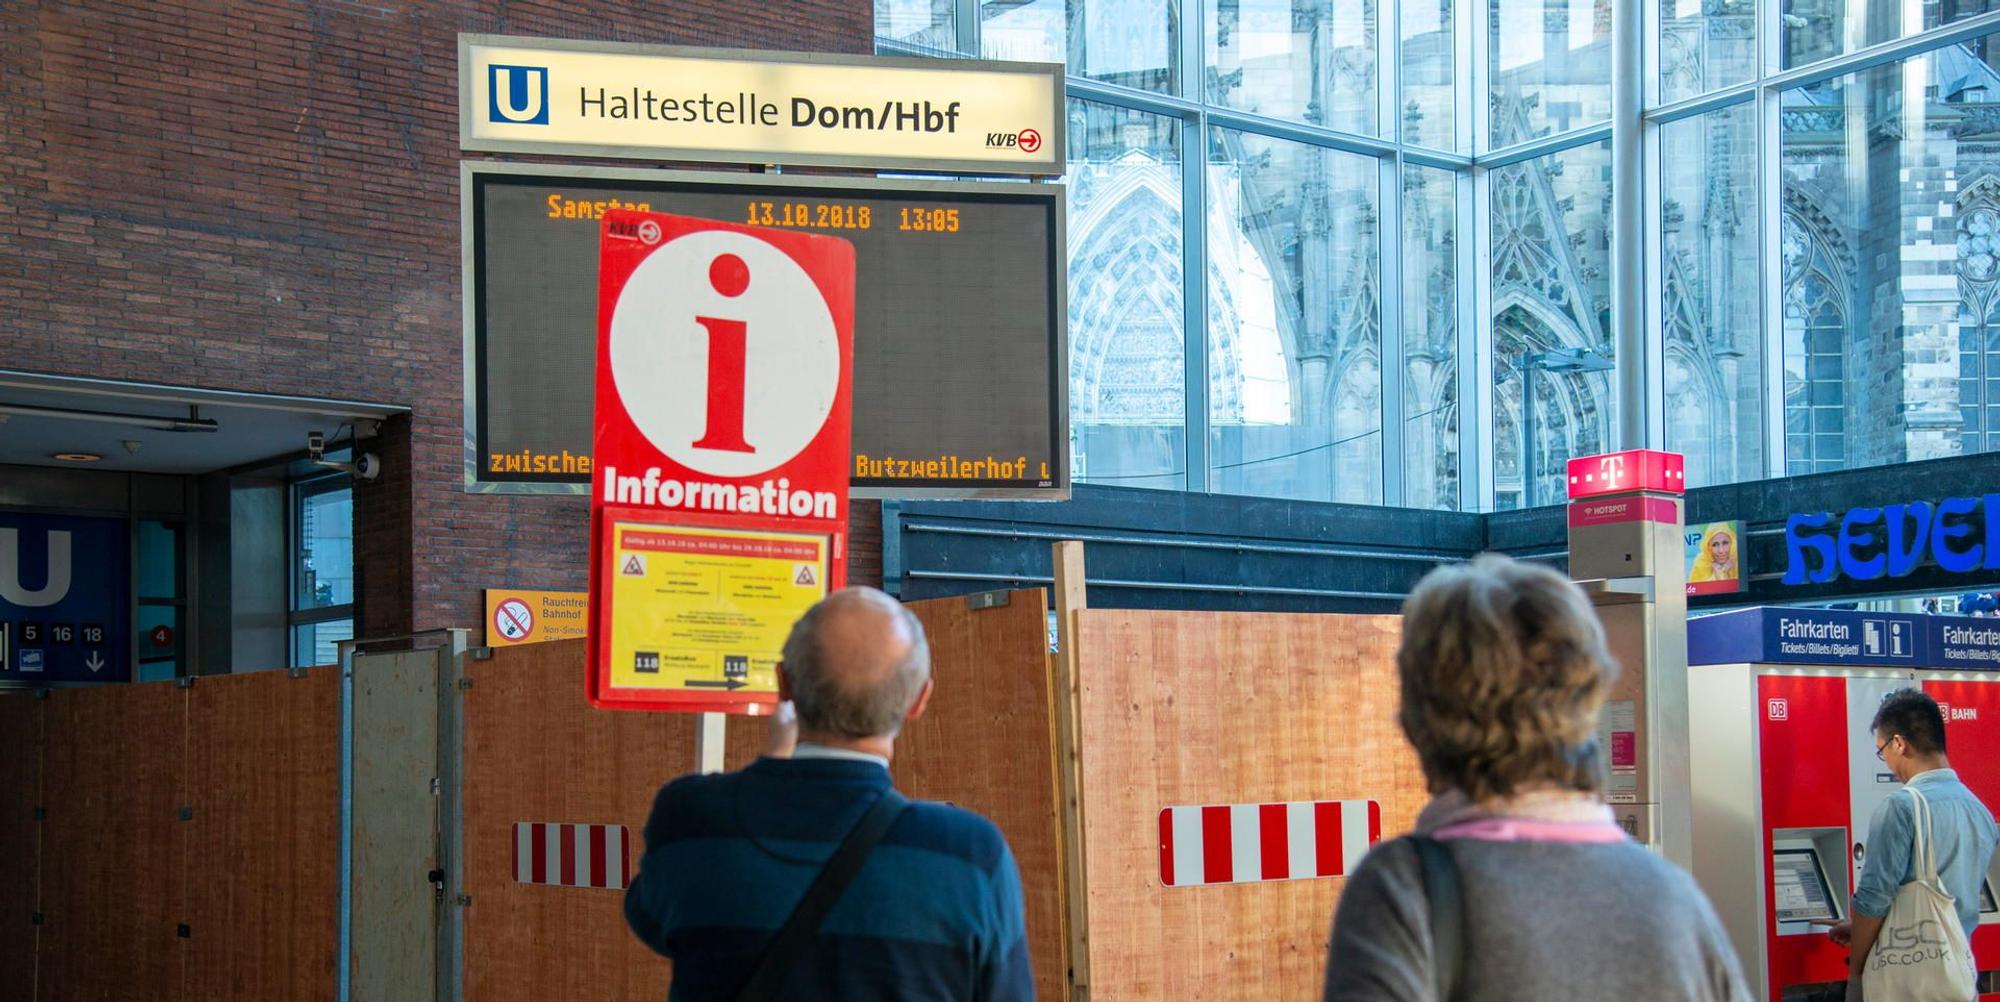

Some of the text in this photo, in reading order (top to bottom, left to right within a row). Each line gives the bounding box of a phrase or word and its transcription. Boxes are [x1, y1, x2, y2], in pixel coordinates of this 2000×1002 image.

[495, 68, 542, 122] U
[581, 87, 960, 133] Haltestelle Dom/Hbf
[985, 133, 1017, 147] KVB
[747, 202, 871, 229] 13.10.2018
[900, 208, 960, 232] 13:05
[692, 253, 756, 454] i
[491, 449, 595, 473] zwische
[856, 454, 1026, 480] Butzweilerhof
[1601, 456, 1624, 489] T
[604, 466, 837, 518] Information
[1594, 504, 1627, 514] HOTSPOT
[0, 528, 71, 607] U
[543, 608, 581, 618] Bahnhof
[25, 626, 102, 642] 5 16 18
[156, 631, 166, 641] 4
[1780, 618, 1849, 639] Fahrkarten
[1943, 625, 2000, 646] Fahrkarte
[636, 657, 658, 669] 118
[725, 661, 747, 672] 118
[1770, 701, 1786, 718] DB
[1951, 708, 1977, 720] BAHN
[1875, 920, 1946, 956] USC
